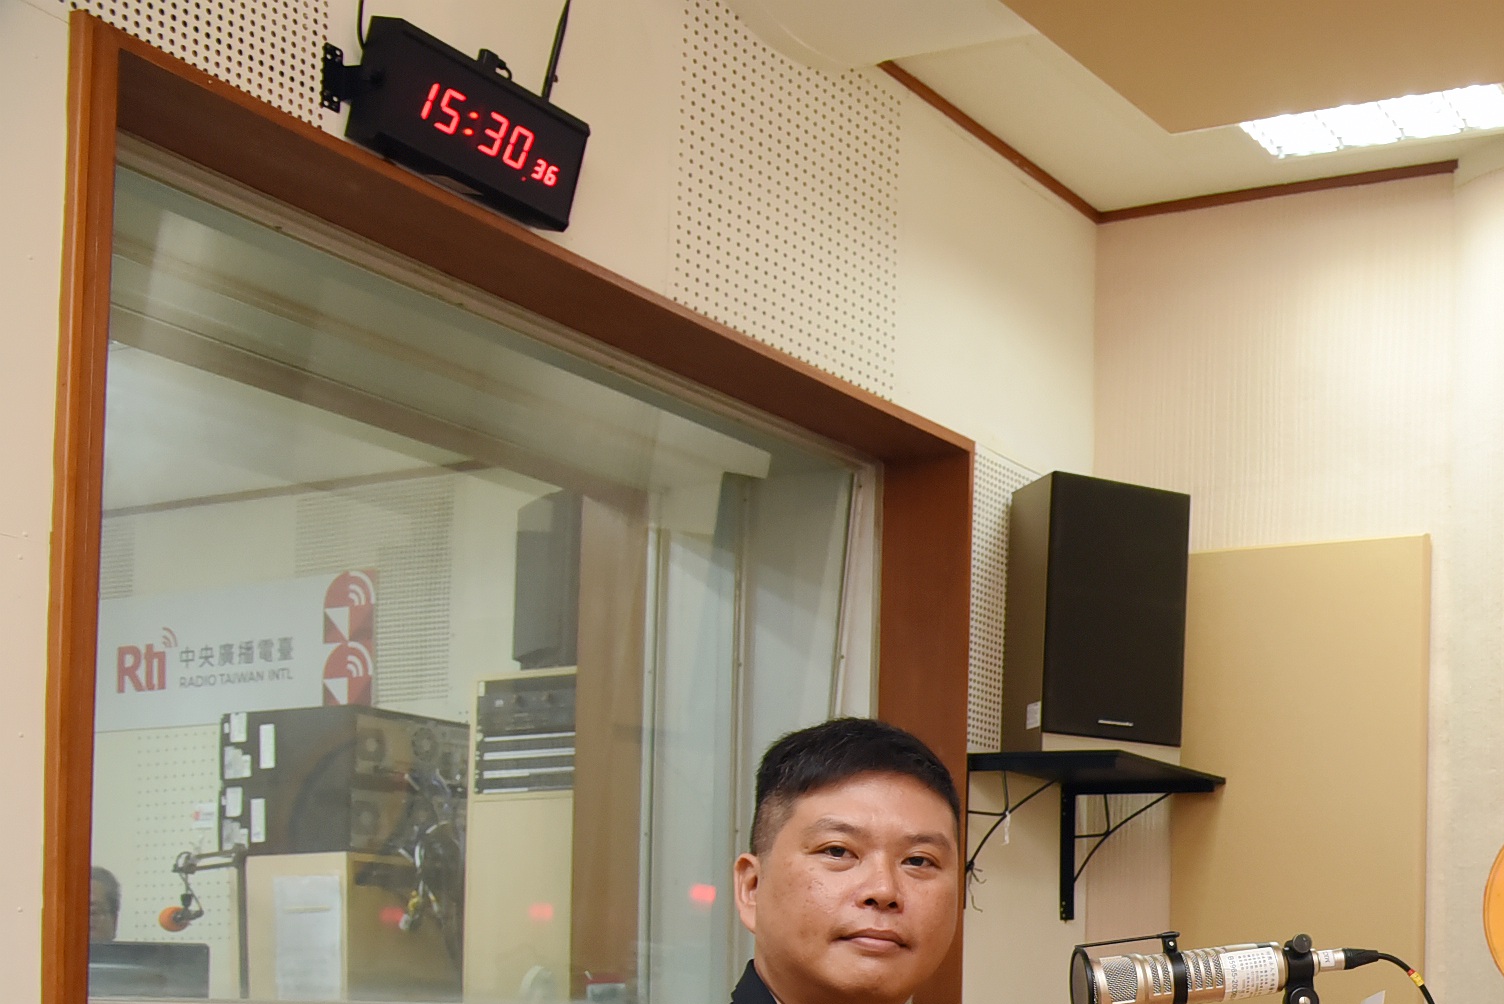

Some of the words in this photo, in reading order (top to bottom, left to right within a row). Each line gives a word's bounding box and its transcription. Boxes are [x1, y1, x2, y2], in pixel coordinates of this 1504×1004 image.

[420, 82, 535, 170] 15:30
[531, 158, 560, 187] 36
[179, 637, 294, 669] 中央廣播電臺
[179, 673, 217, 688] RADIO
[218, 670, 264, 685] TAIWAN
